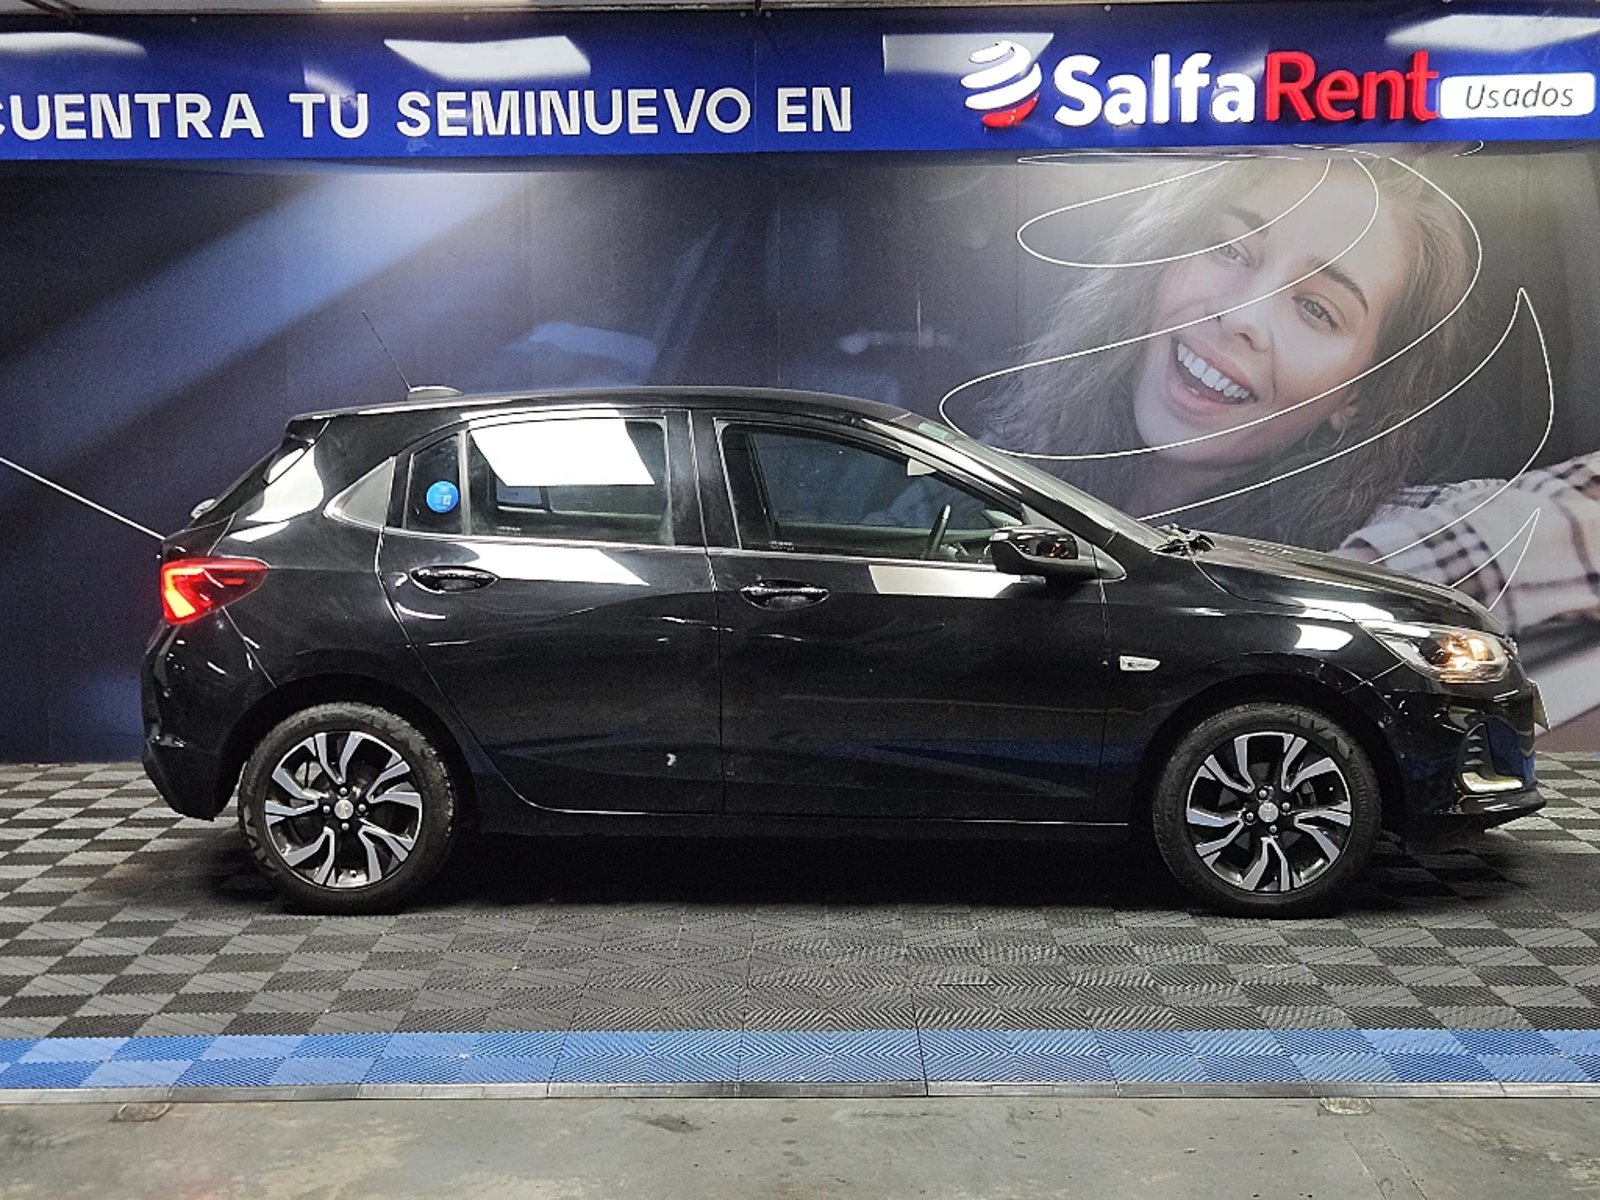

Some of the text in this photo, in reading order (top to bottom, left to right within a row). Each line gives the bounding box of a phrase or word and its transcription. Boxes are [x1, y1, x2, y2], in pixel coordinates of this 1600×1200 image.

[0, 87, 852, 140] UENTRA TU SEMINUEVO EN
[1053, 50, 1574, 127] SalfaRent Usados
